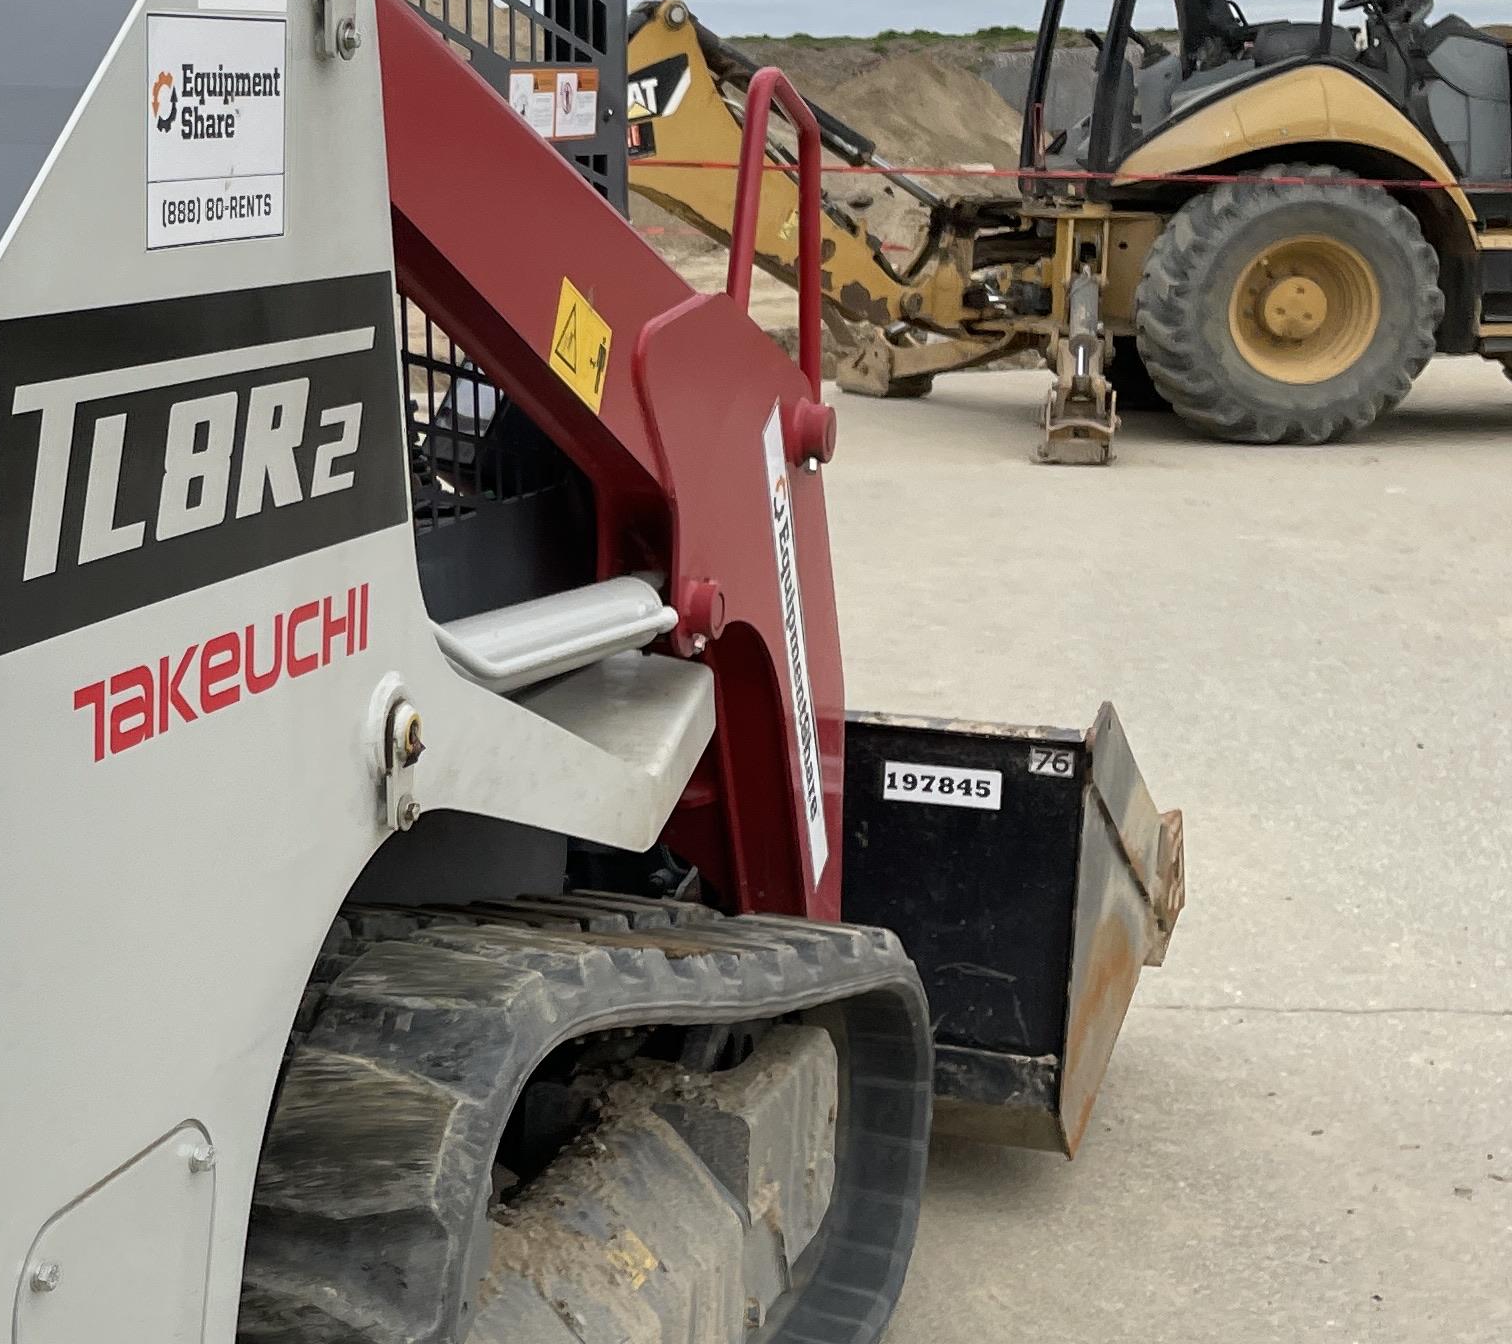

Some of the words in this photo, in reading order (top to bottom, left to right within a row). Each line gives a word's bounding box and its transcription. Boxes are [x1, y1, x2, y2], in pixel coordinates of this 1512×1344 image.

[182, 64, 280, 105] Equipment
[627, 77, 658, 116] AT
[181, 107, 235, 139] Share
[162, 197, 200, 227] (888)
[206, 194, 271, 221] 80-RENTS
[12, 326, 376, 582] TL8R2
[1034, 750, 1069, 774] 76
[886, 771, 991, 798] 197845
